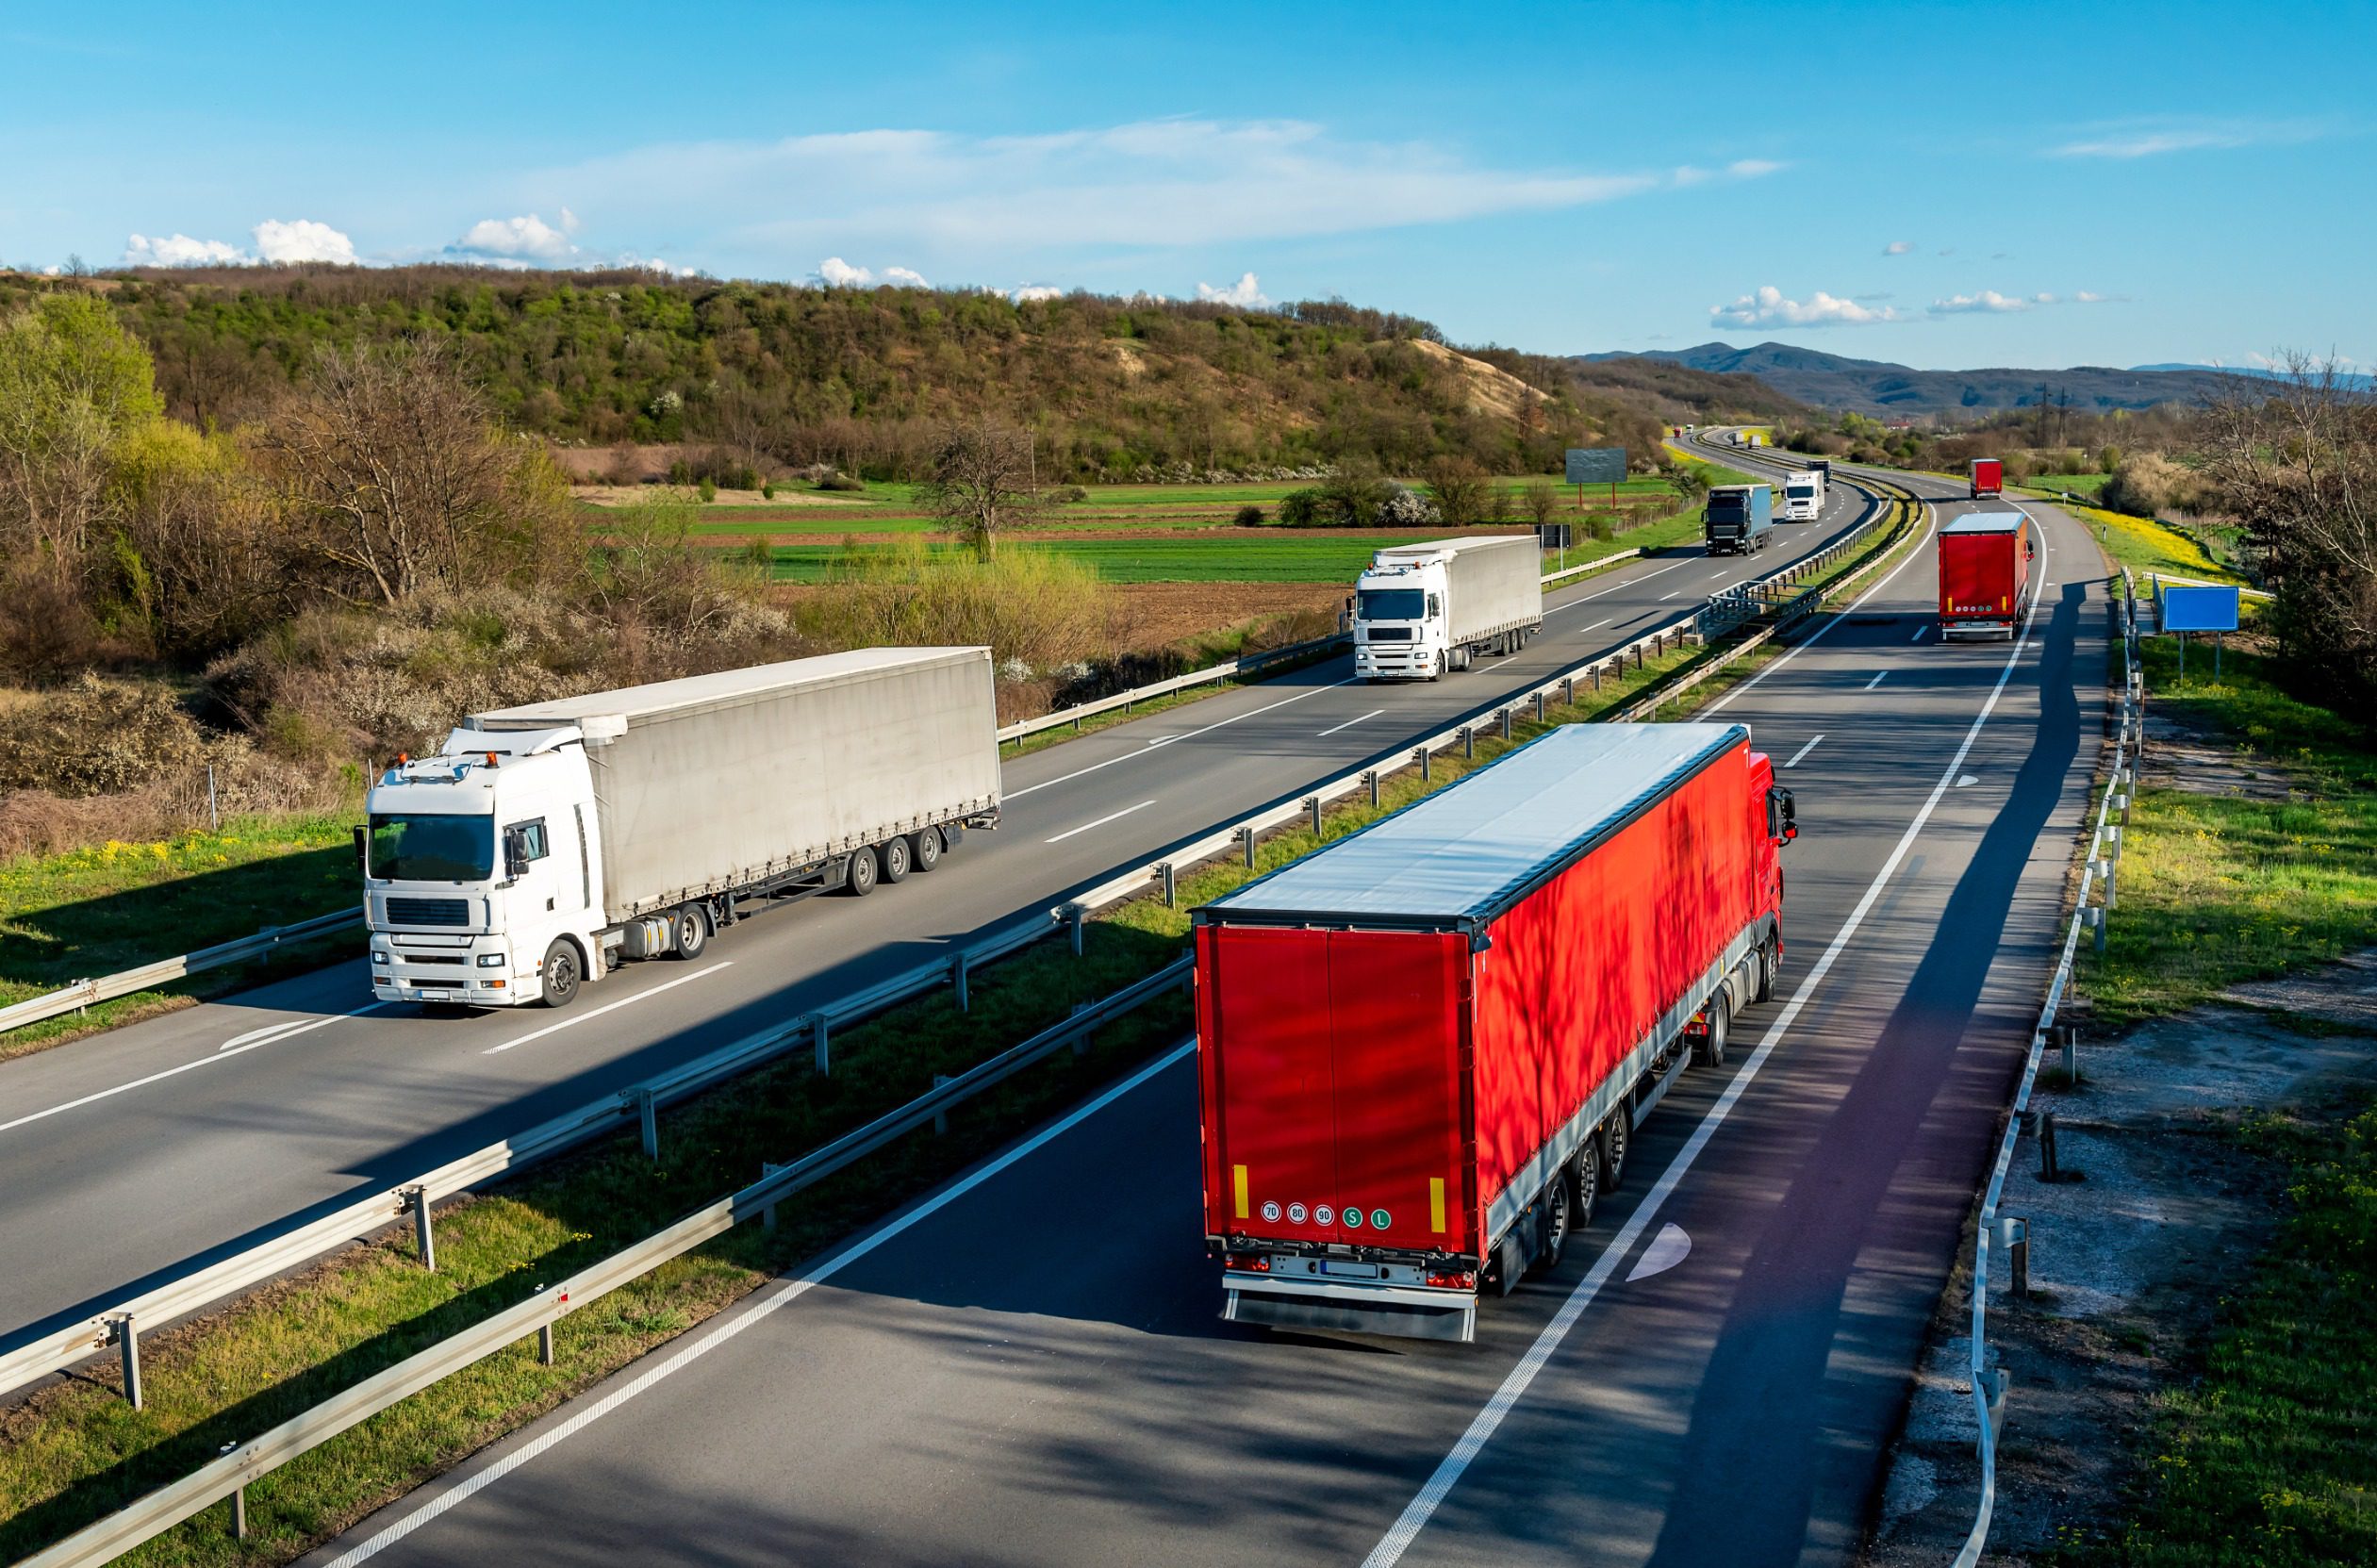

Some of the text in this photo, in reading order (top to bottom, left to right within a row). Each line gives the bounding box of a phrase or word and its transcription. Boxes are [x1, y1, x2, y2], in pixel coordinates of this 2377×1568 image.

[1266, 1207, 1385, 1226] 70 80 90 S L
